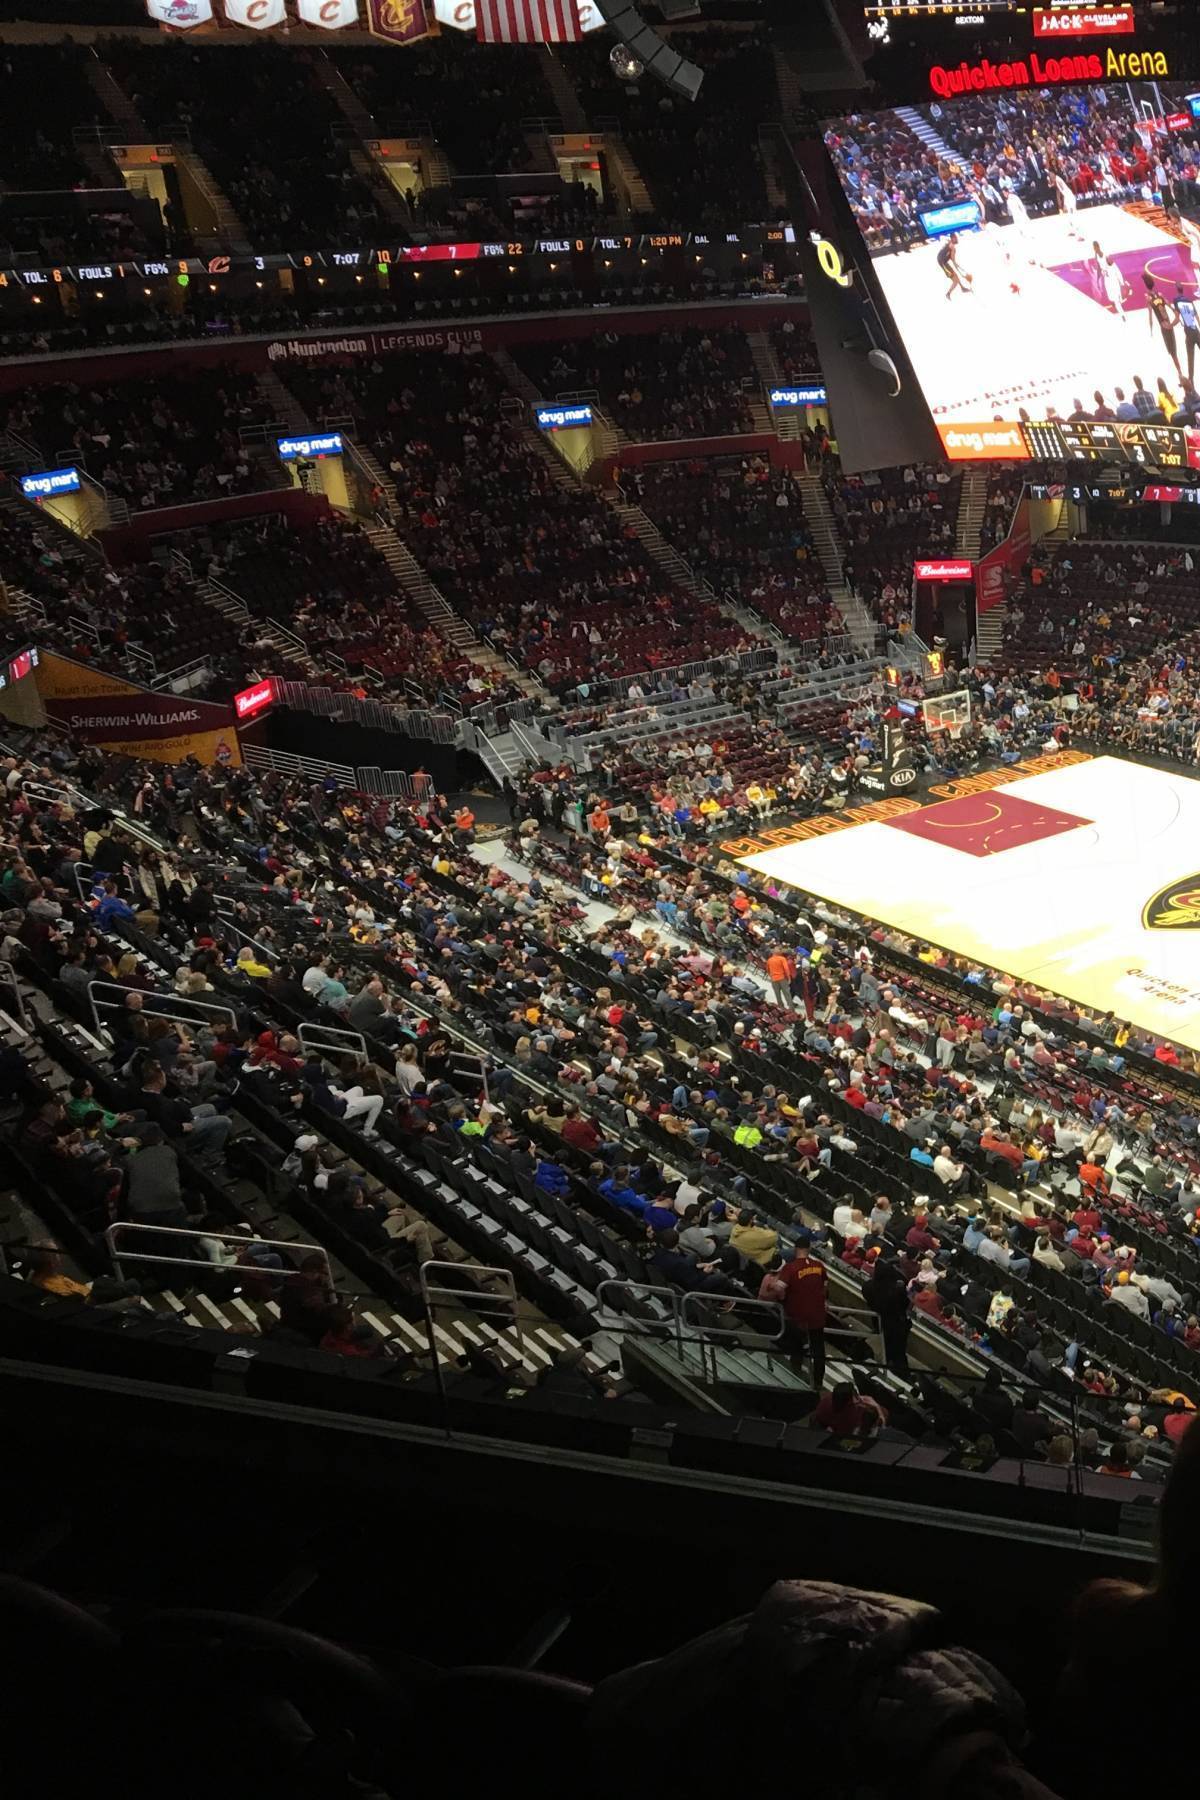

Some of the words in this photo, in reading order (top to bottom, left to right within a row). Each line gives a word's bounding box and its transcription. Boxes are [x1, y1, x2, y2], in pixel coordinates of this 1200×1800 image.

[929, 59, 1028, 97] Quicken
[1030, 52, 1102, 83] Loans
[1106, 48, 1168, 77] Arena
[540, 241, 570, 252] FOULS
[600, 238, 620, 249] TOL:
[624, 238, 632, 248] 7
[669, 236, 682, 245] PM
[449, 246, 457, 258] 7
[484, 244, 504, 255] FG%
[508, 243, 523, 255] 22
[254, 256, 264, 270] 3
[304, 256, 312, 266] 9
[333, 253, 360, 264] 7:07
[812, 240, 849, 286] Q
[79, 266, 112, 280] FOULS
[144, 263, 169, 275] FG%
[179, 260, 188, 273] 9
[23, 271, 48, 284] TOL:
[53, 269, 62, 282] 6
[771, 389, 798, 403] drug
[798, 389, 826, 400] mart
[538, 409, 565, 424] drug
[565, 407, 592, 420] mart
[279, 438, 310, 455] drug
[311, 435, 342, 450] mart
[946, 431, 984, 451] drug
[983, 429, 1021, 446] mart
[1134, 445, 1145, 462] 3
[1160, 453, 1181, 466] 7:07
[23, 474, 51, 492] drug
[51, 471, 78, 488] mart
[1073, 488, 1081, 498] 3
[1109, 489, 1126, 497] 7:07
[1153, 488, 1160, 499] 7
[918, 565, 970, 576] Budweiser
[894, 772, 912, 784] KIA
[929, 750, 1094, 800] CAVALIERS
[720, 797, 922, 857] CLEVELAND
[1126, 967, 1190, 994] Quicken
[1141, 985, 1186, 1006] Arena
